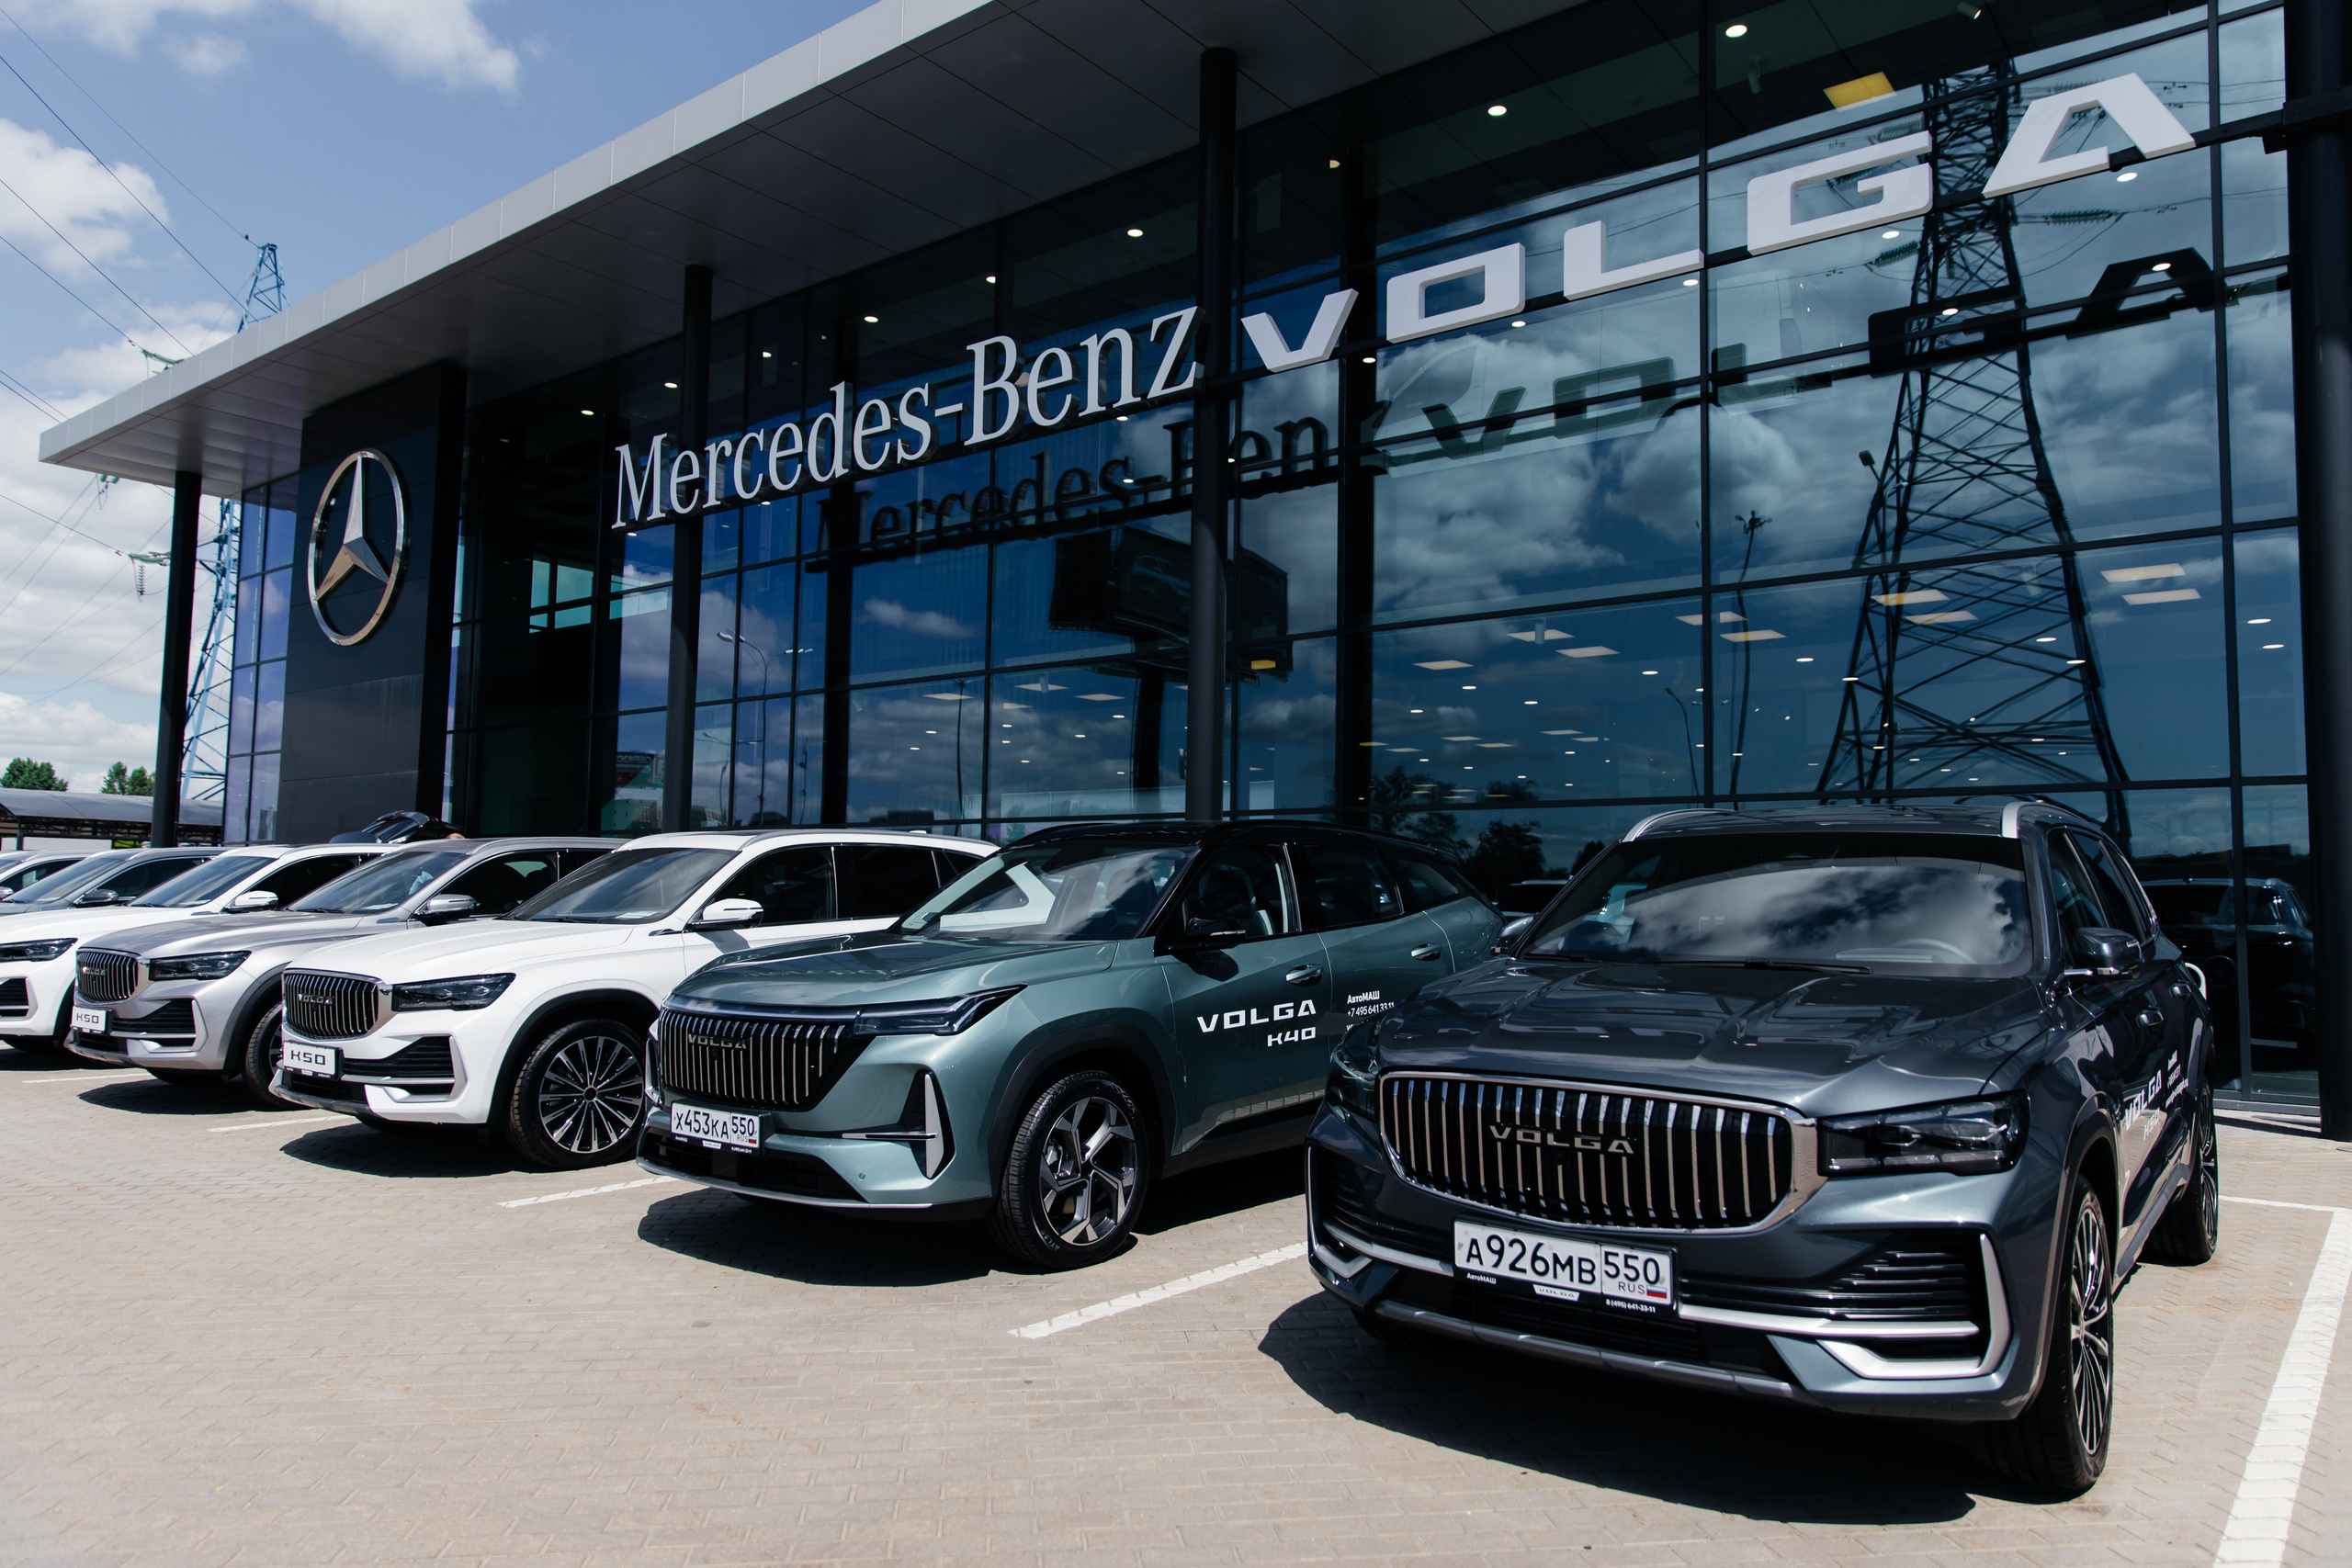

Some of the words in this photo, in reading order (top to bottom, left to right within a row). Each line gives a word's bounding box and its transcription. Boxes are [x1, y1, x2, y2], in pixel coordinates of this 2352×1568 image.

[1241, 72, 2195, 372] VOLGA
[611, 306, 1202, 529] Mercedes-Benz
[1347, 990, 1380, 1004] АвтоМАШ
[1197, 999, 1317, 1033] VOLGA
[1355, 1006, 1368, 1016] 495
[1368, 1004, 1379, 1014] 641
[76, 1013, 99, 1024] K50
[687, 1033, 747, 1049] VOLGA
[1267, 1026, 1317, 1047] K40
[290, 1050, 326, 1066] K50
[2124, 1069, 2162, 1131] VOLGA
[731, 1115, 755, 1137] 550
[736, 1134, 749, 1143] RUS
[1489, 1125, 1634, 1155] VOLGA
[1603, 1250, 1660, 1285] 550
[1466, 1272, 1497, 1284] АвтоМАШ
[1538, 1287, 1575, 1299] VOLGA
[1618, 1281, 1645, 1294] RUS
